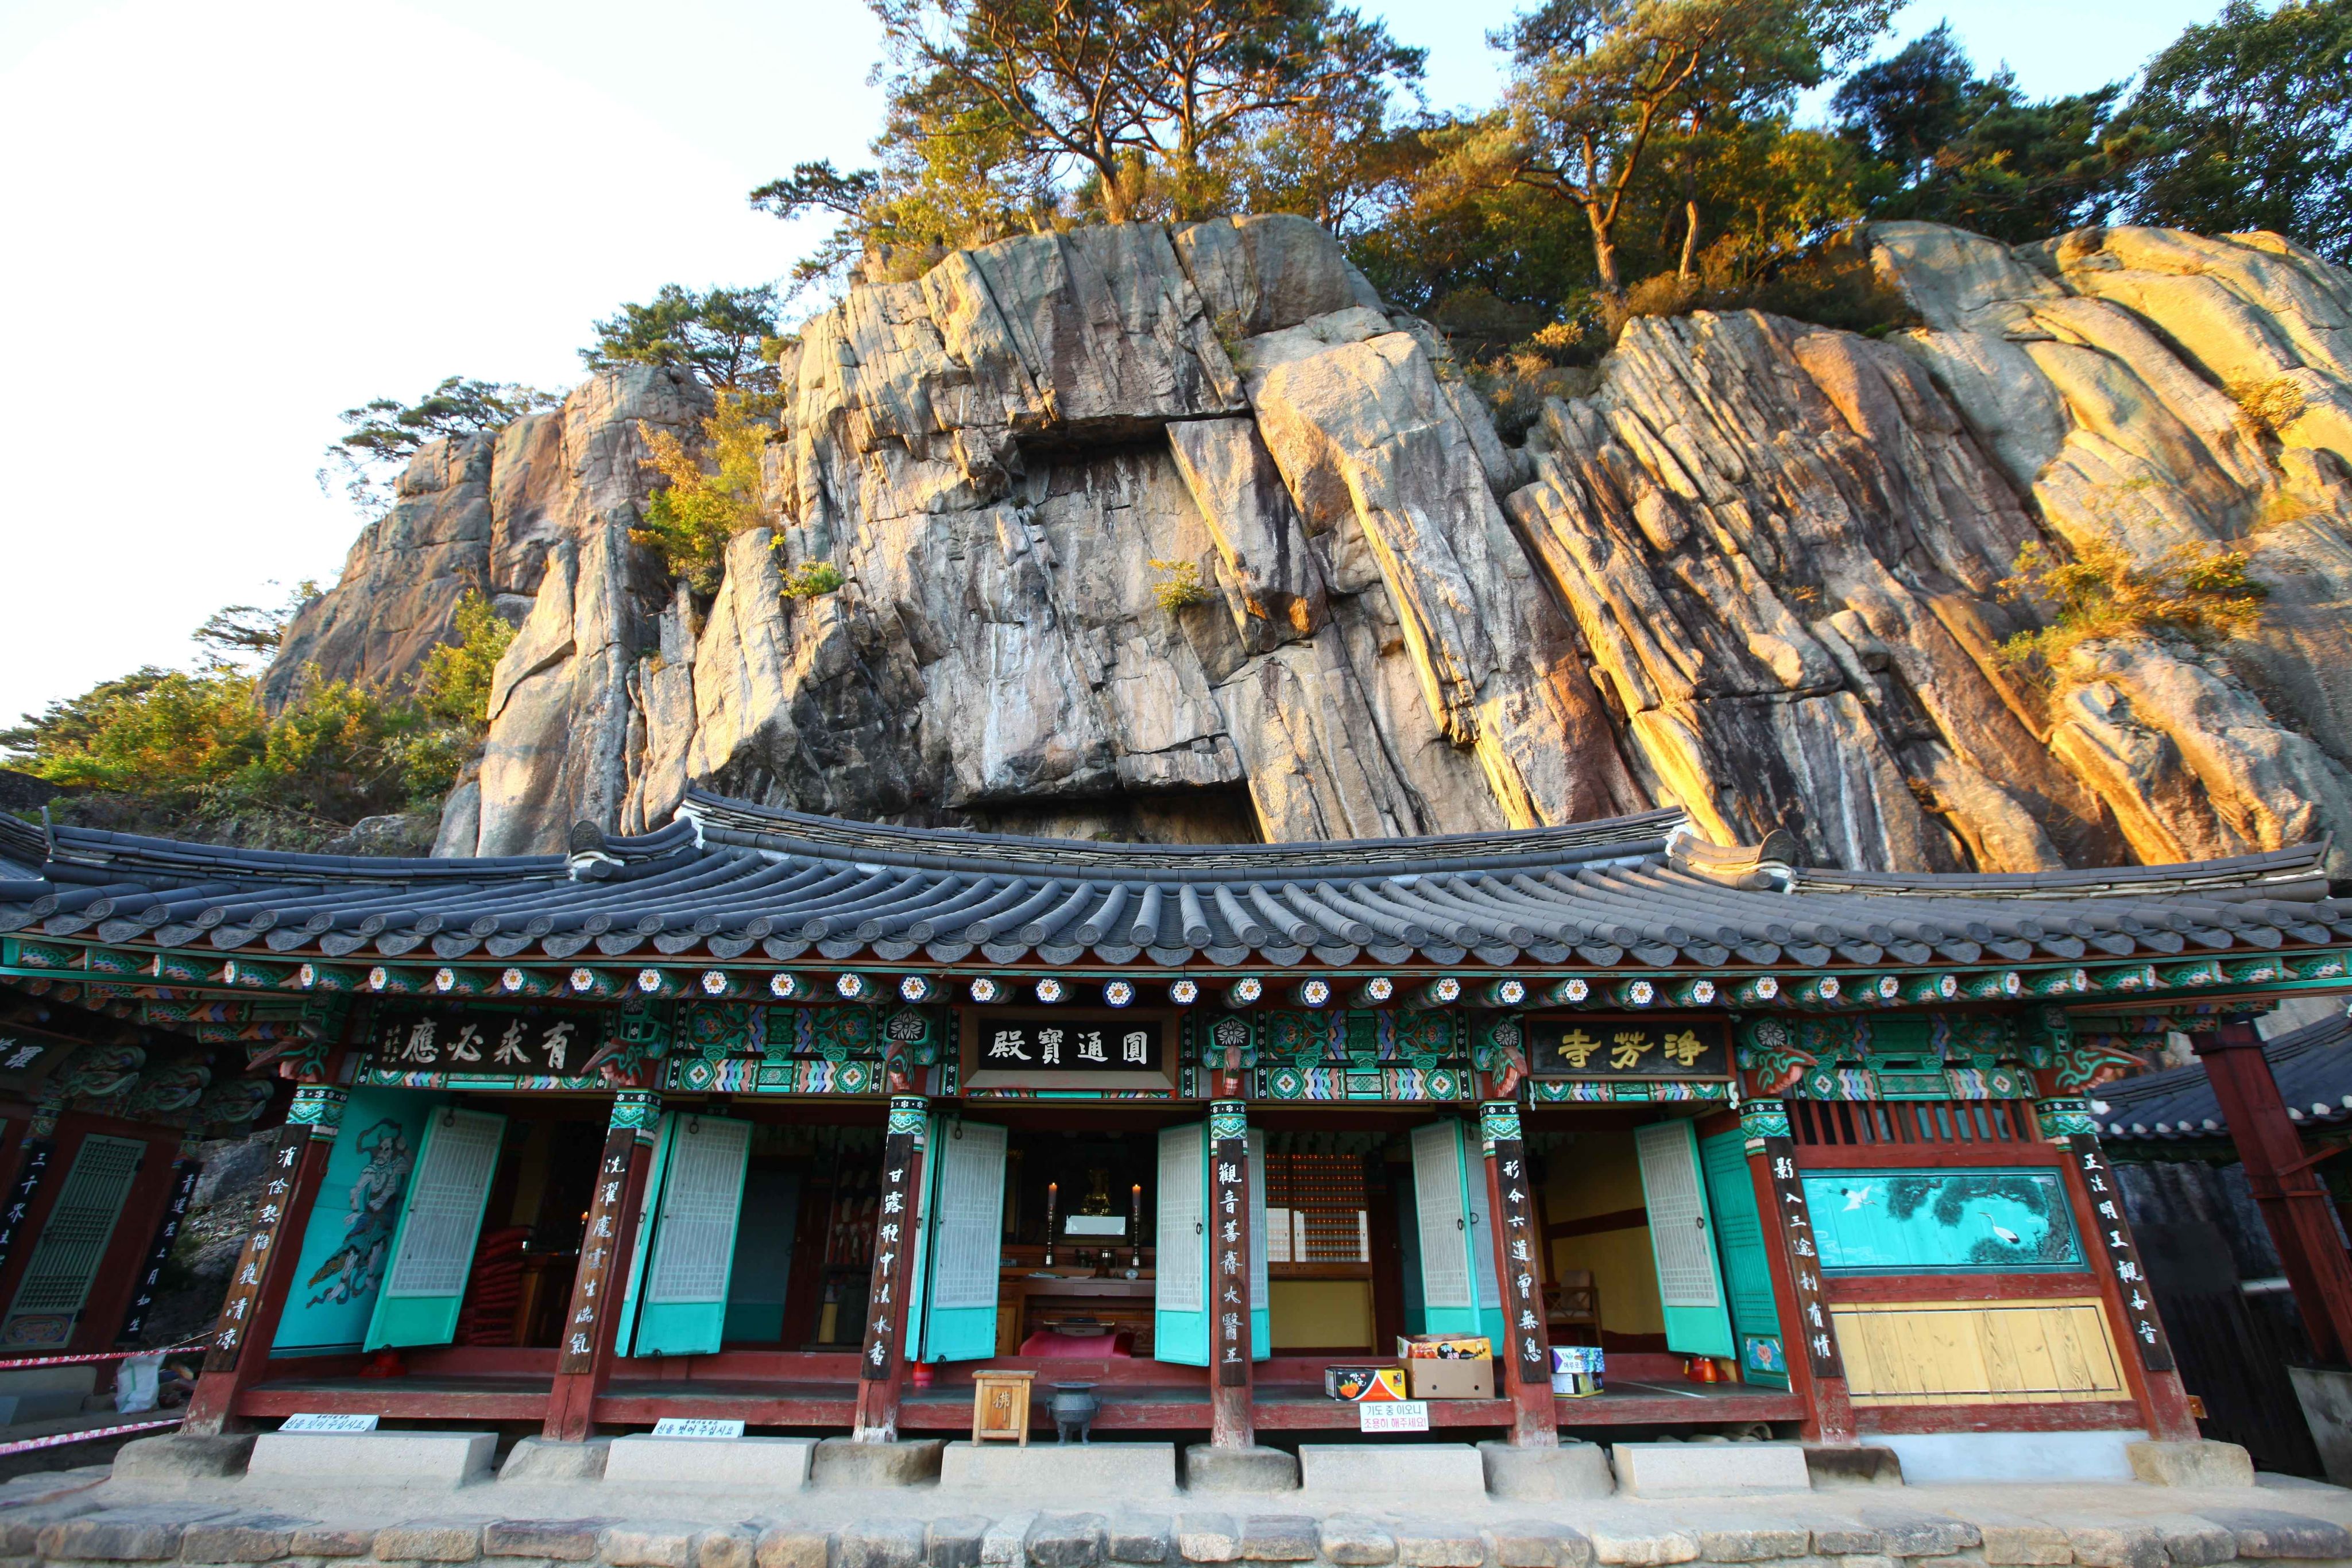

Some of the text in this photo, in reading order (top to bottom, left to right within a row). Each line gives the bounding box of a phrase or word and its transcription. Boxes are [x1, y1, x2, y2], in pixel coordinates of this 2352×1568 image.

[988, 1028, 1148, 1065] 圓通寶殿
[993, 1391, 1011, 1422] 佛
[1366, 1404, 1421, 1416] 기도 중 이오니
[1364, 1417, 1426, 1429] 조용히 해주세요!
[657, 1424, 674, 1434] 신을
[678, 1424, 697, 1436] 벗어
